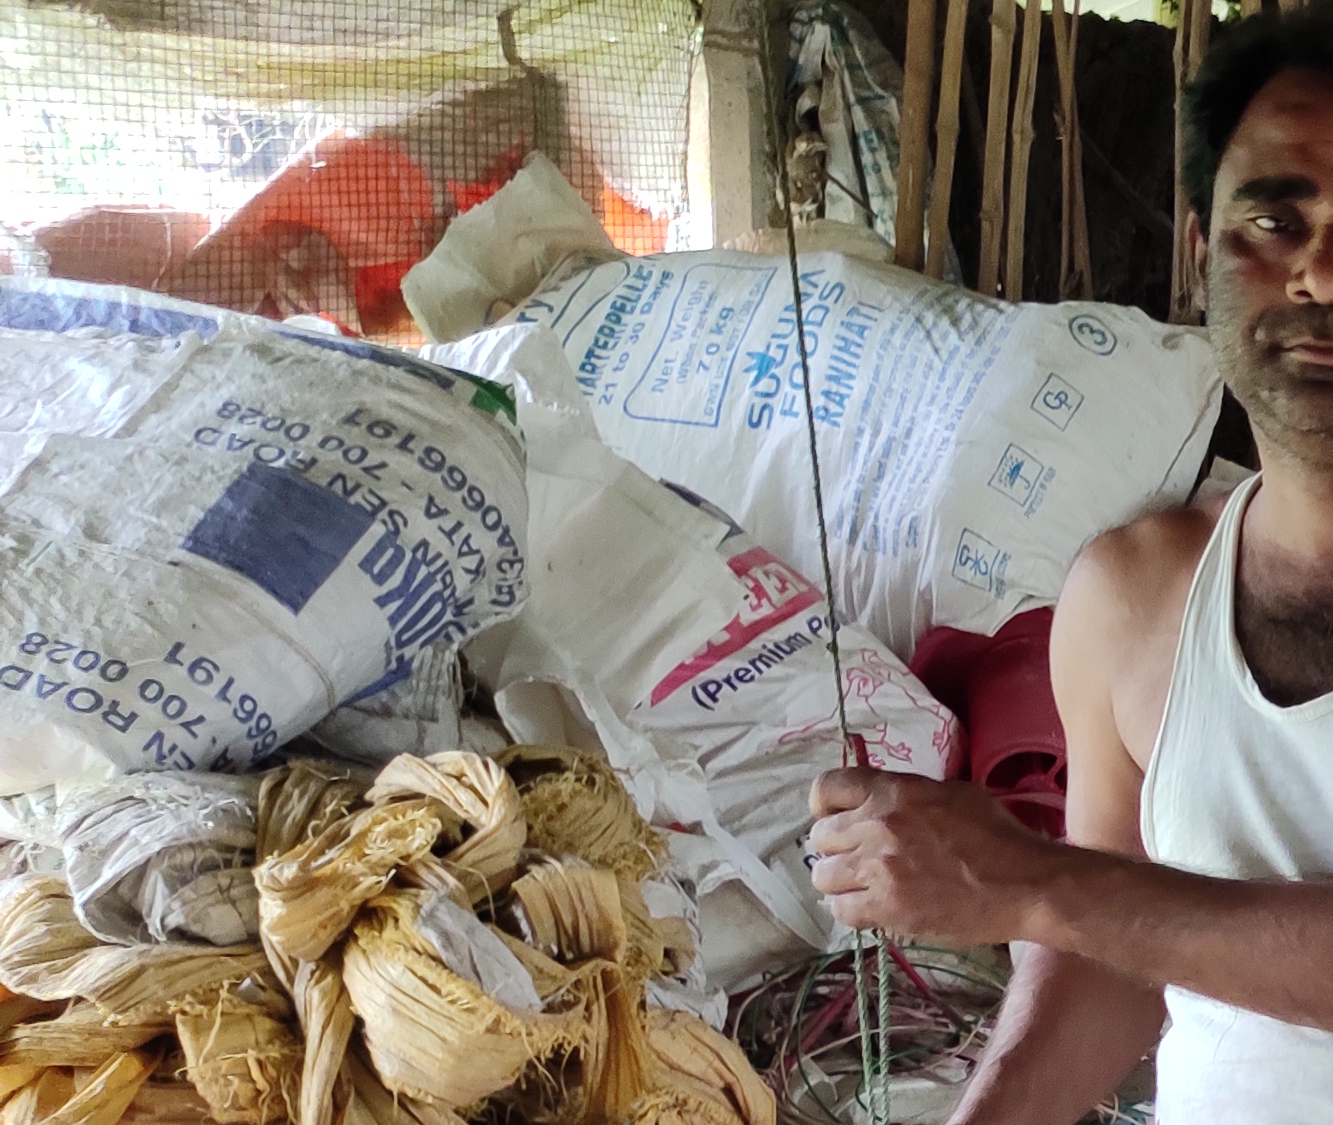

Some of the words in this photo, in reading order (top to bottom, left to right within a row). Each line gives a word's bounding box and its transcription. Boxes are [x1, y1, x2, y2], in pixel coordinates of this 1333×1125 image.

[612, 351, 631, 373] to
[780, 280, 846, 419] FOODS
[813, 300, 886, 429] RANIHATI
[1077, 321, 1108, 347] 3
[215, 400, 311, 442] 0028
[318, 434, 390, 482] 700
[327, 472, 410, 540] SEN
[19, 631, 130, 683] 0028
[691, 631, 813, 712] (Premium
[0, 665, 140, 734] ROAD
[139, 678, 207, 740] 700
